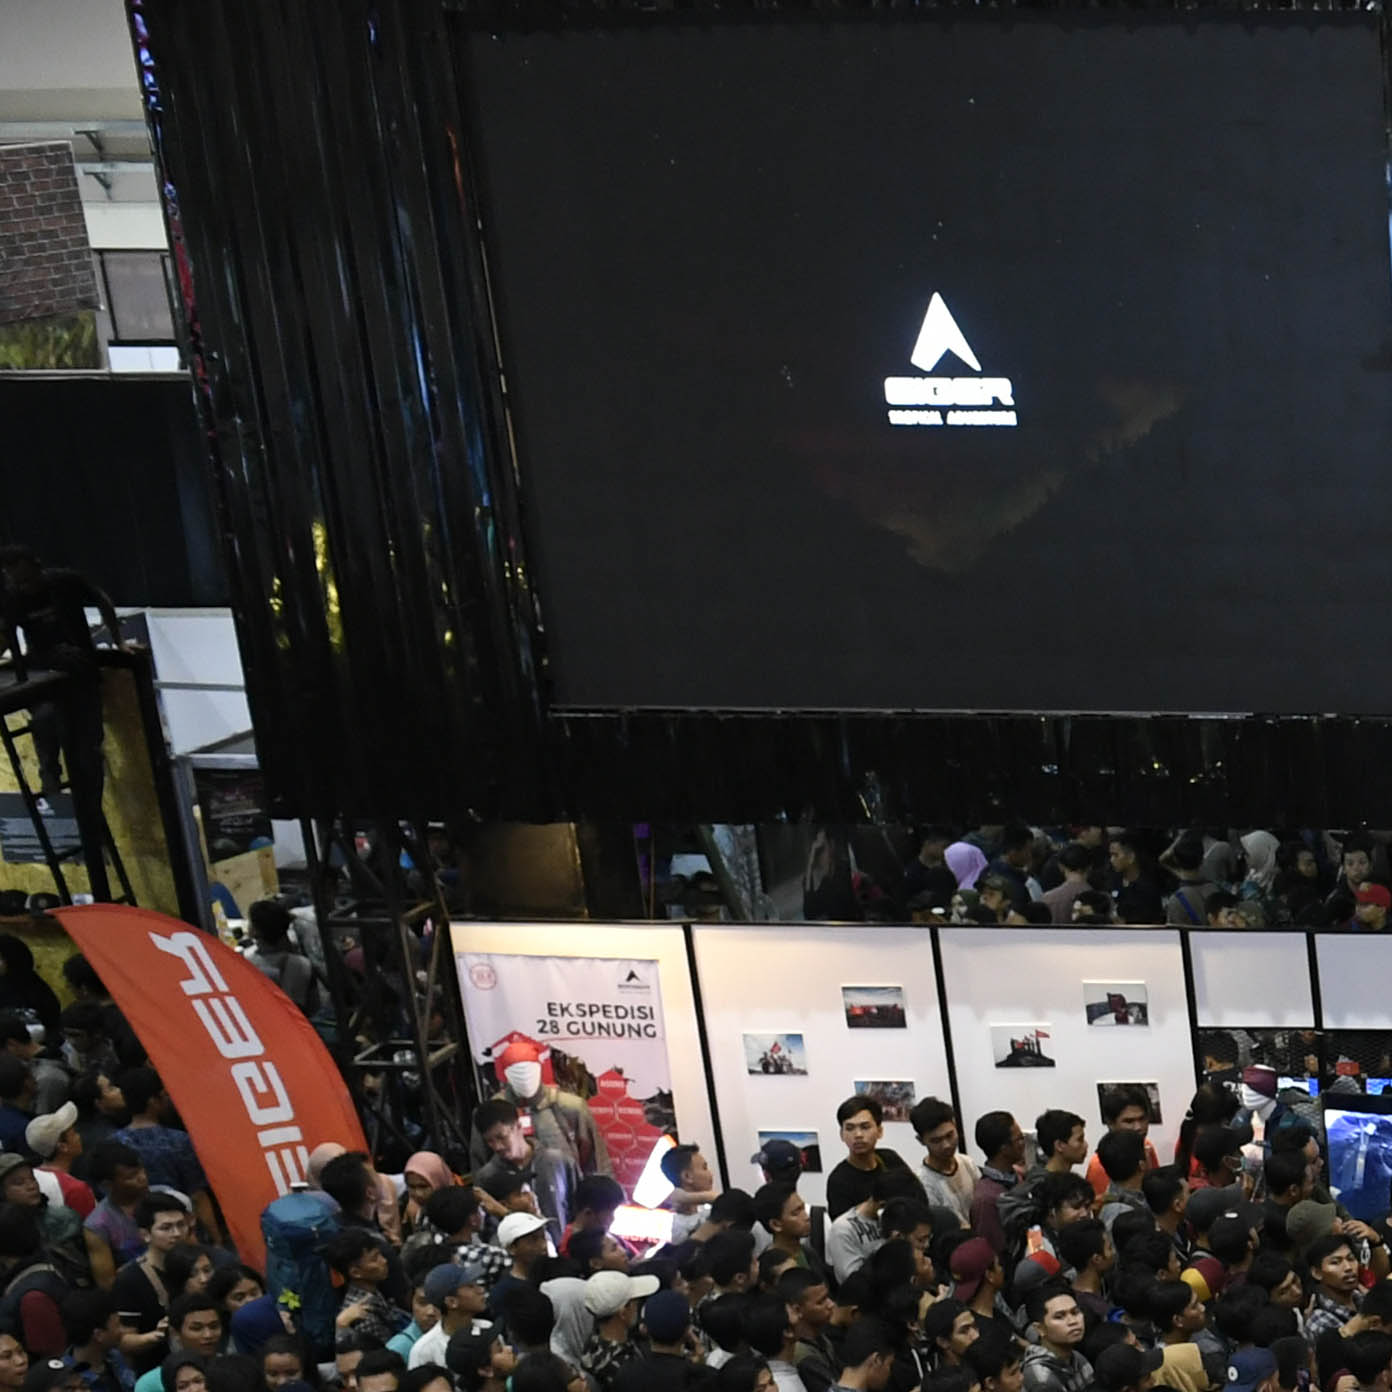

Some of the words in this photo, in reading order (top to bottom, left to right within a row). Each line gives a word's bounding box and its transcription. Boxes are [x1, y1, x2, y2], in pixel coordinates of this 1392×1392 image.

[546, 1001, 655, 1021] EKSPEDISI
[536, 1019, 560, 1035] 28
[566, 1020, 657, 1039] GUNUNG
